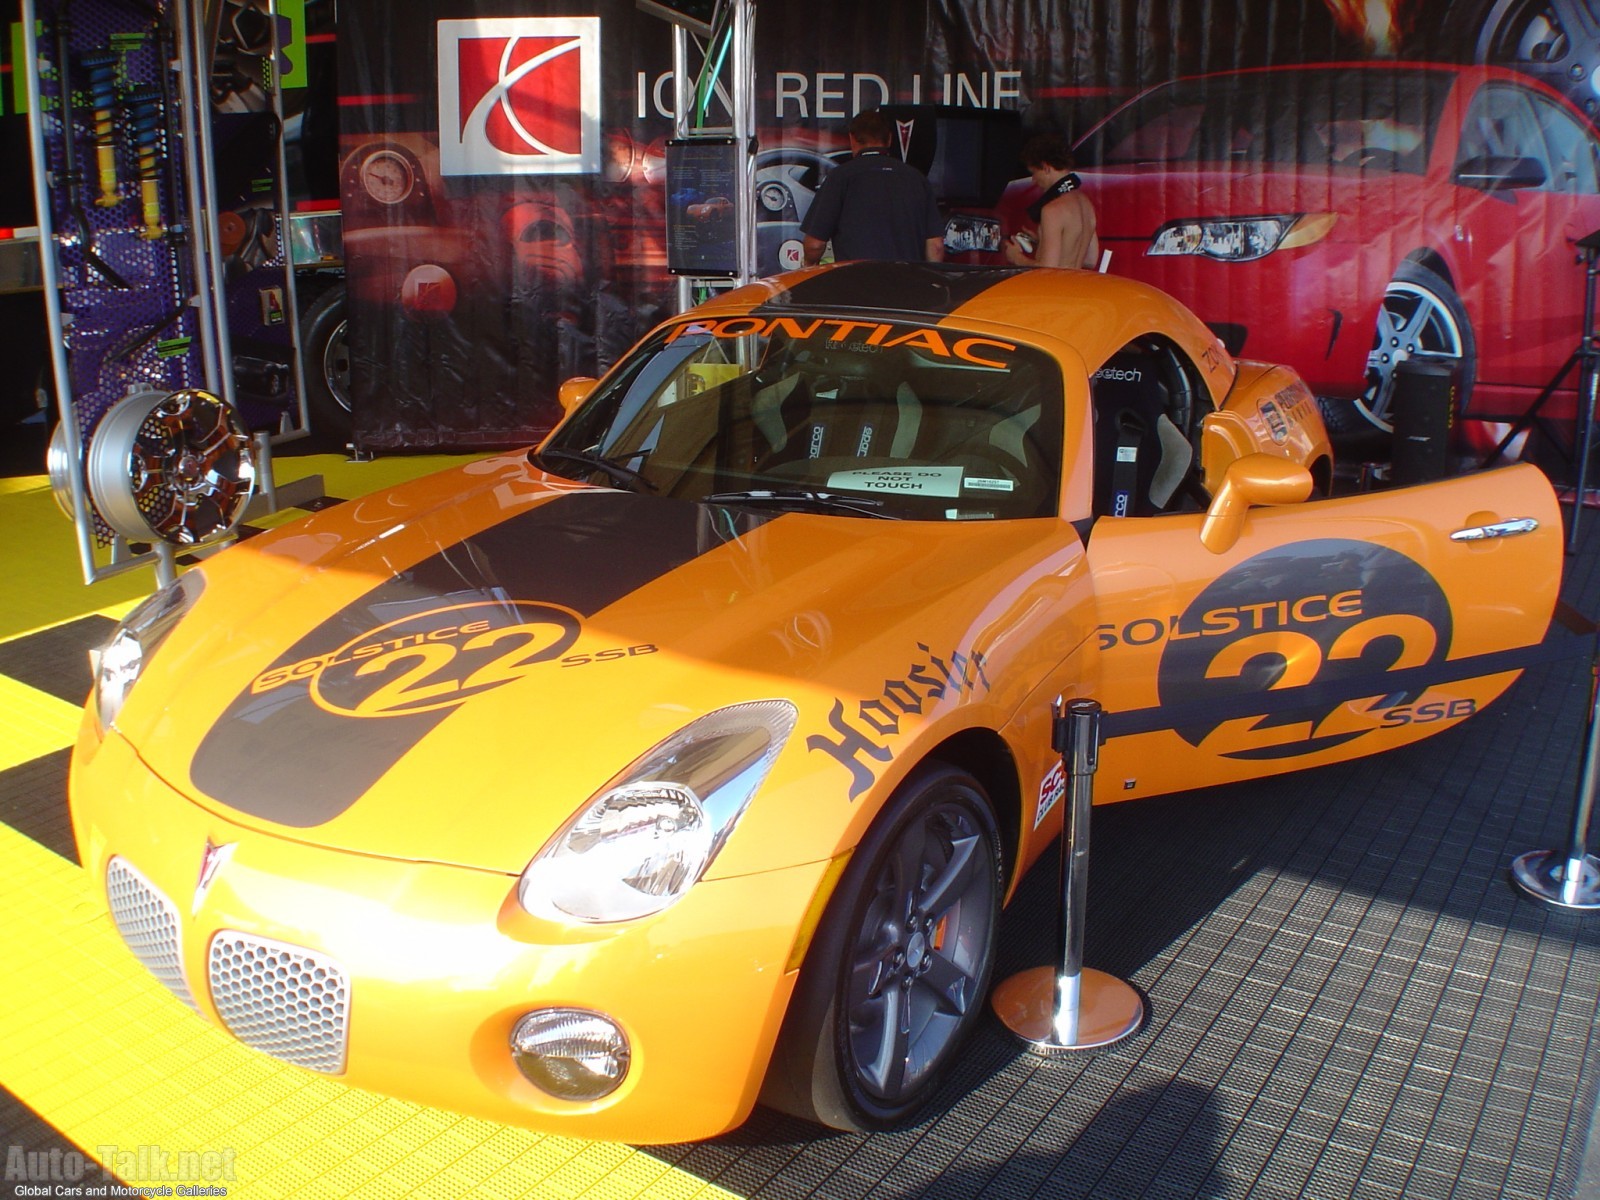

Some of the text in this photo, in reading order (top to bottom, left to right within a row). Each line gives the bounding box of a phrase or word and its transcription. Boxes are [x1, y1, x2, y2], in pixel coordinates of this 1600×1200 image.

[637, 71, 734, 118] ION
[775, 72, 890, 118] RED
[664, 317, 1017, 369] PONTIAC
[864, 481, 923, 490] TOUCH
[1099, 589, 1363, 651] SOLSTICE
[256, 619, 490, 690] SOLSTICE
[350, 622, 566, 713] 22
[560, 643, 660, 668] SSB
[1200, 613, 1438, 753] 22
[1379, 698, 1477, 729] SSB
